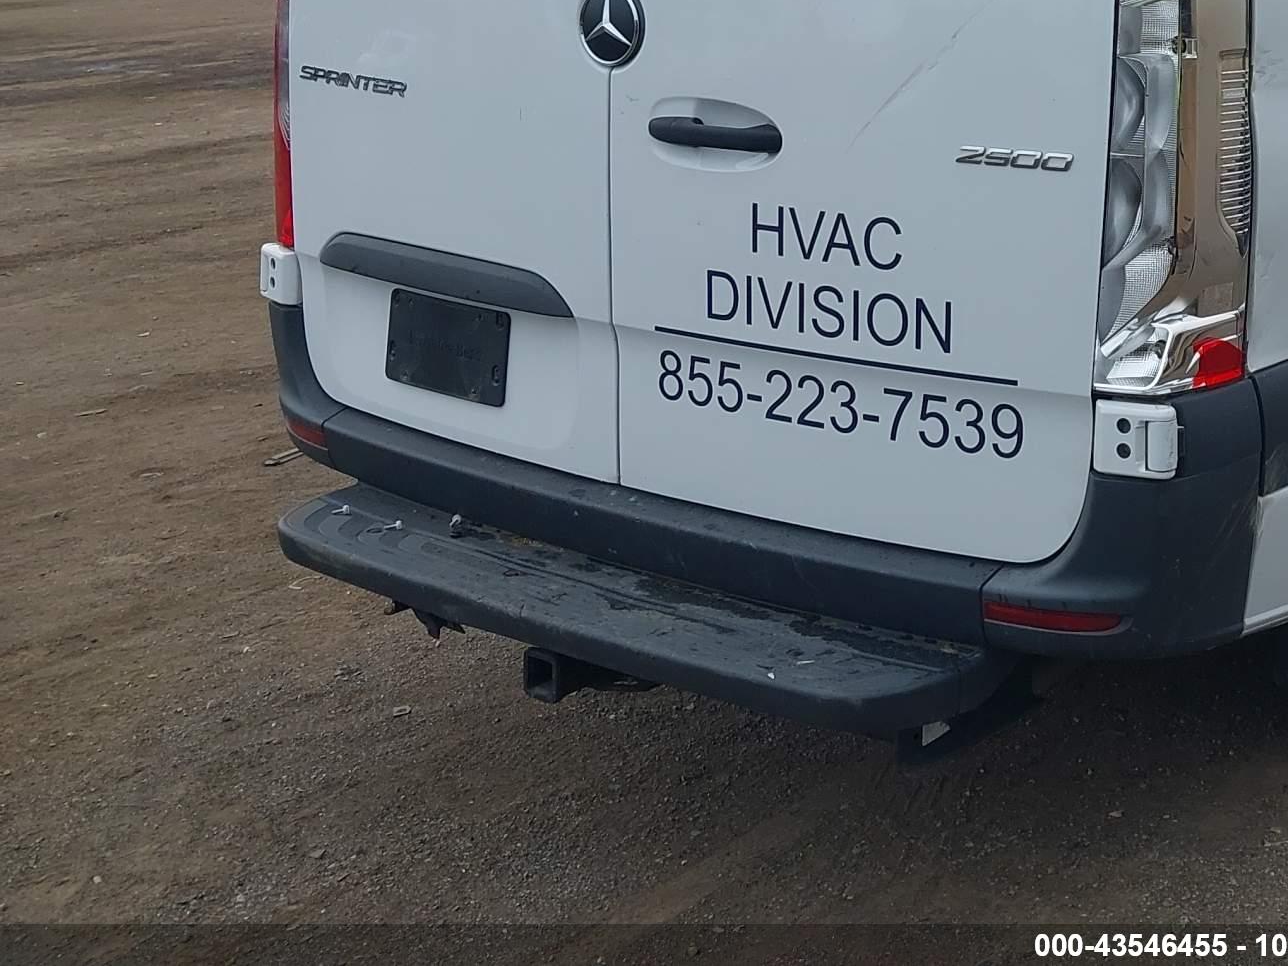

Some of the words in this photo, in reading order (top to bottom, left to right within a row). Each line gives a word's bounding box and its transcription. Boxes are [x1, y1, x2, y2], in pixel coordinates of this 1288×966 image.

[299, 65, 408, 98] SPRINTER
[955, 145, 1075, 172] 2500
[750, 202, 904, 270] HVAC
[706, 270, 953, 354] DIVISION
[658, 349, 1025, 459] 855-223-7539
